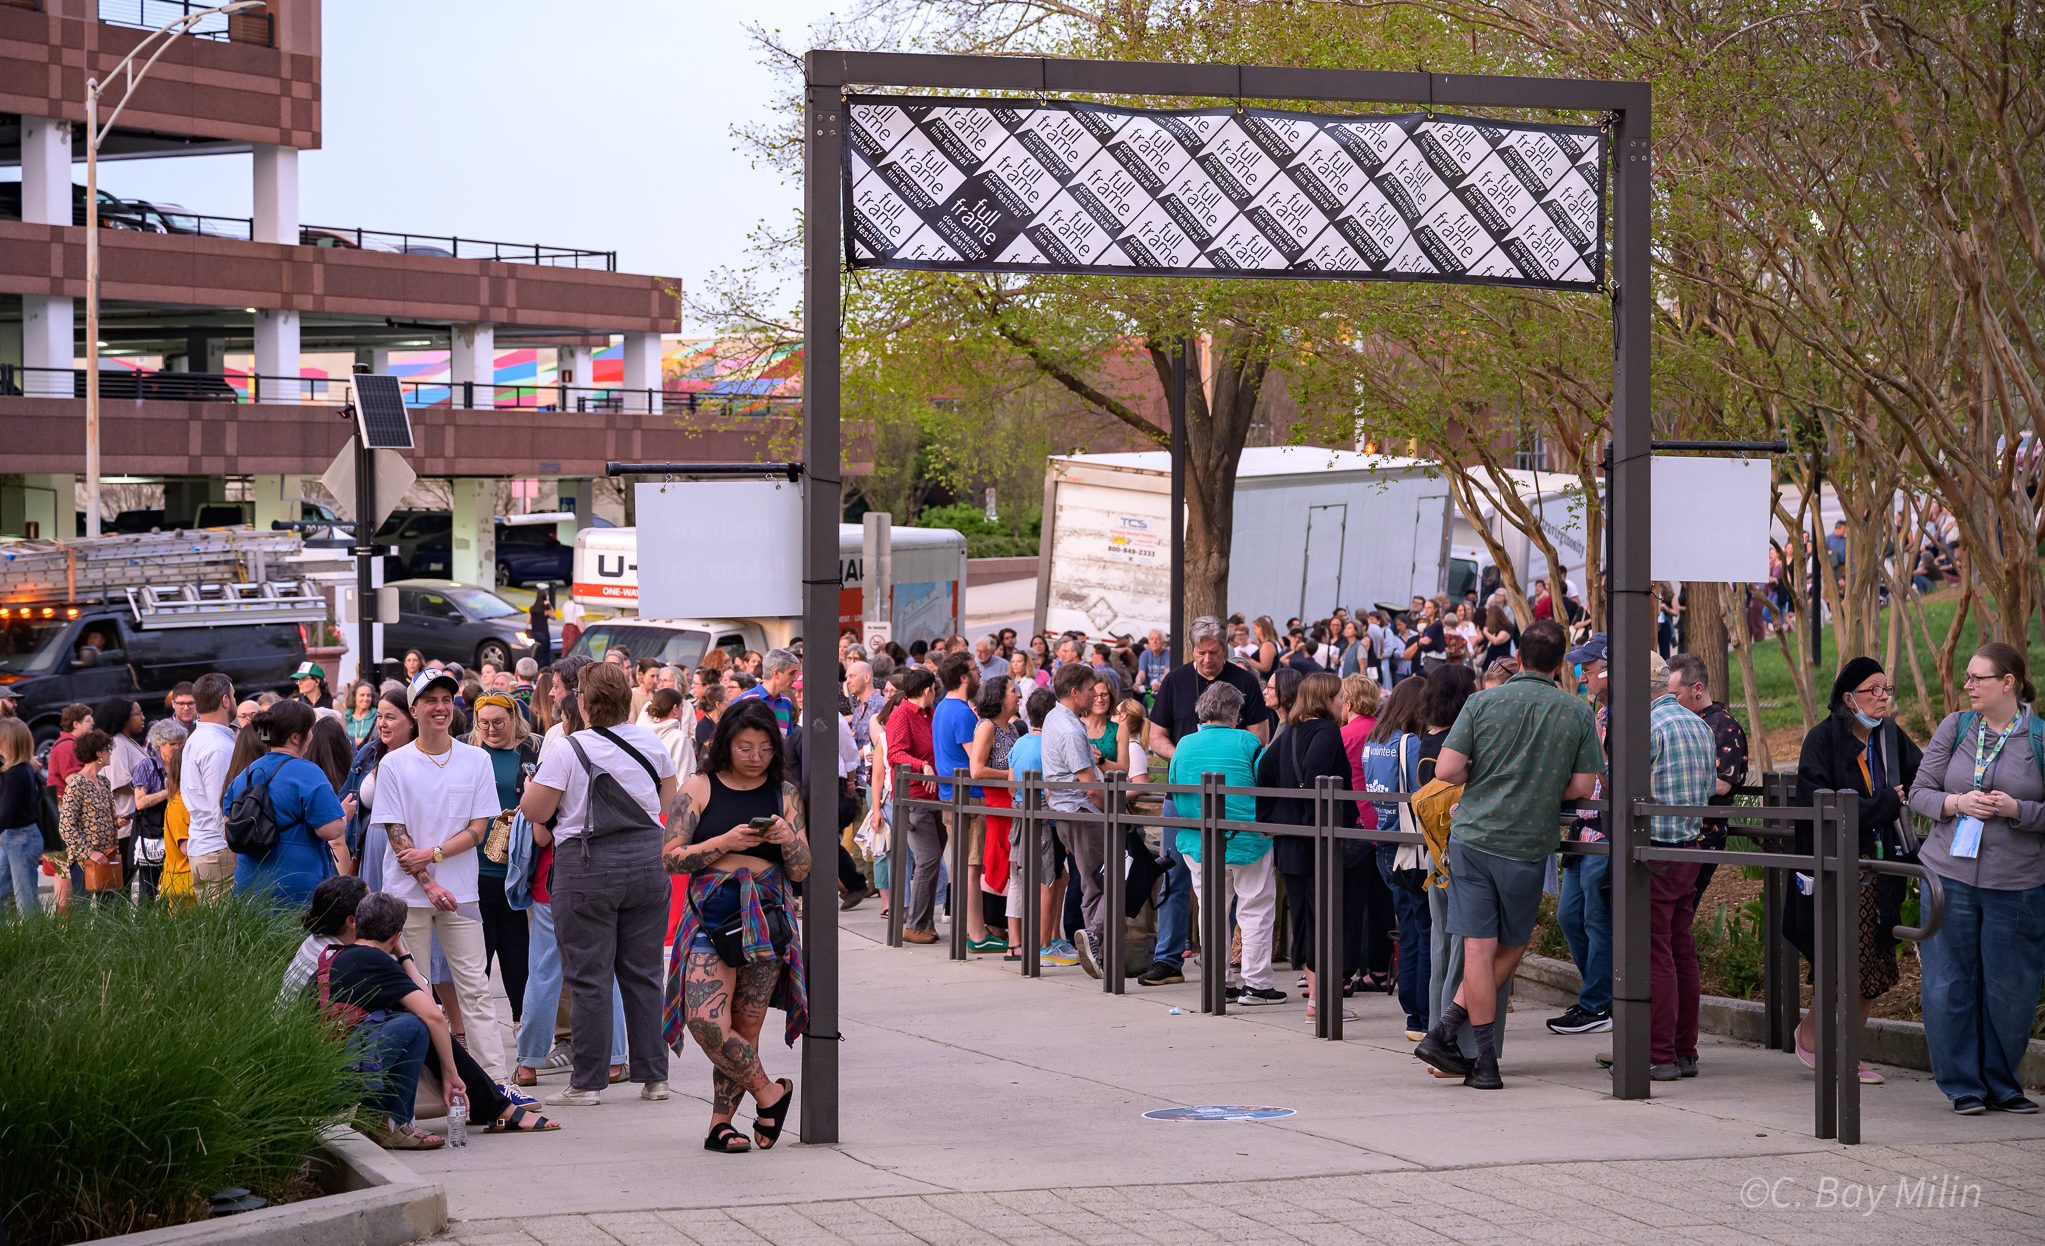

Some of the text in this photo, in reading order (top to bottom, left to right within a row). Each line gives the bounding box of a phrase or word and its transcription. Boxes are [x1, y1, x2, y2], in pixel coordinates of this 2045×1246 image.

[929, 128, 968, 168] film festival
[934, 121, 977, 166] documentary
[1036, 116, 1078, 163] frame
[1057, 117, 1084, 144] full
[1149, 128, 1176, 156] full
[1250, 117, 1292, 156] ocumentary
[1256, 130, 1283, 158] festival
[1534, 135, 1558, 162] full
[921, 148, 950, 176] full
[1016, 156, 1044, 184] full
[1024, 138, 1062, 177] film festival
[1028, 132, 1070, 176] documentary
[1115, 150, 1153, 189] film festival
[1120, 144, 1161, 187] documentary
[1128, 128, 1170, 174] frame
[1216, 139, 1257, 186] frame
[1236, 140, 1263, 168] full
[1328, 149, 1355, 177] full
[1348, 140, 1372, 168] festival
[1418, 140, 1452, 180] film festival
[1424, 133, 1462, 178] documentary
[1508, 148, 1545, 192] documentary
[1515, 133, 1553, 180] frame
[886, 171, 925, 211] film festival
[891, 165, 934, 209] documentary
[899, 148, 943, 196] frame
[995, 156, 1039, 203] frame
[1108, 170, 1136, 197] full
[1204, 161, 1240, 201] film festival
[1208, 156, 1248, 199] documentary
[1294, 172, 1331, 211] film festival
[1299, 166, 1339, 209] documentary
[1307, 149, 1348, 196] frame
[1394, 159, 1428, 206] frame
[1411, 159, 1434, 187] full
[1499, 171, 1526, 199] full
[1504, 154, 1537, 193] film festival
[879, 192, 906, 219] full
[972, 199, 1002, 226] full
[983, 179, 1022, 218] film festival
[988, 173, 1031, 216] documentary
[1075, 191, 1112, 230] film festival
[1080, 186, 1121, 229] documentary
[1087, 169, 1130, 216] frame
[1177, 180, 1217, 227] frame
[1197, 181, 1223, 209] full
[1287, 192, 1314, 220] full
[1382, 182, 1412, 221] film festival
[1387, 176, 1419, 219] documentary
[1469, 187, 1506, 231] documentary
[1478, 170, 1517, 218] frame
[1559, 187, 1595, 233] frame
[857, 190, 901, 238] frame
[951, 198, 996, 246] frame
[1069, 210, 1096, 238] full
[1165, 202, 1201, 242] film festival
[1170, 196, 1209, 240] documentary
[1258, 209, 1299, 252] documentary
[1266, 192, 1308, 239] frame
[1355, 202, 1394, 249] frame
[1375, 202, 1400, 230] full
[1454, 213, 1481, 240] full
[1463, 193, 1498, 233] film festival
[1547, 207, 1580, 246] film festival
[1552, 202, 1587, 245] documentary
[857, 225, 884, 253] festival
[937, 221, 951, 236] film
[950, 233, 978, 260] festival
[942, 215, 988, 259] documentary
[1034, 233, 1046, 246] film
[1046, 245, 1068, 266] festiv
[1040, 227, 1080, 266] documentar
[1047, 210, 1090, 257] frame
[1125, 244, 1137, 257] film
[1158, 222, 1185, 249] full
[1226, 234, 1267, 270] fram
[1246, 234, 1272, 261] full
[1253, 214, 1290, 253] film festival
[1342, 225, 1376, 264] film festival
[1347, 219, 1385, 262] documentary
[1424, 229, 1463, 272] documentary
[1432, 212, 1473, 259] frame
[1509, 246, 1520, 259] film
[1521, 225, 1559, 271] frame
[1540, 226, 1565, 253] full
[1418, 234, 1454, 274] film festival
[1120, 517, 1147, 528] TCS
[1370, 746, 1398, 757] voluntee
